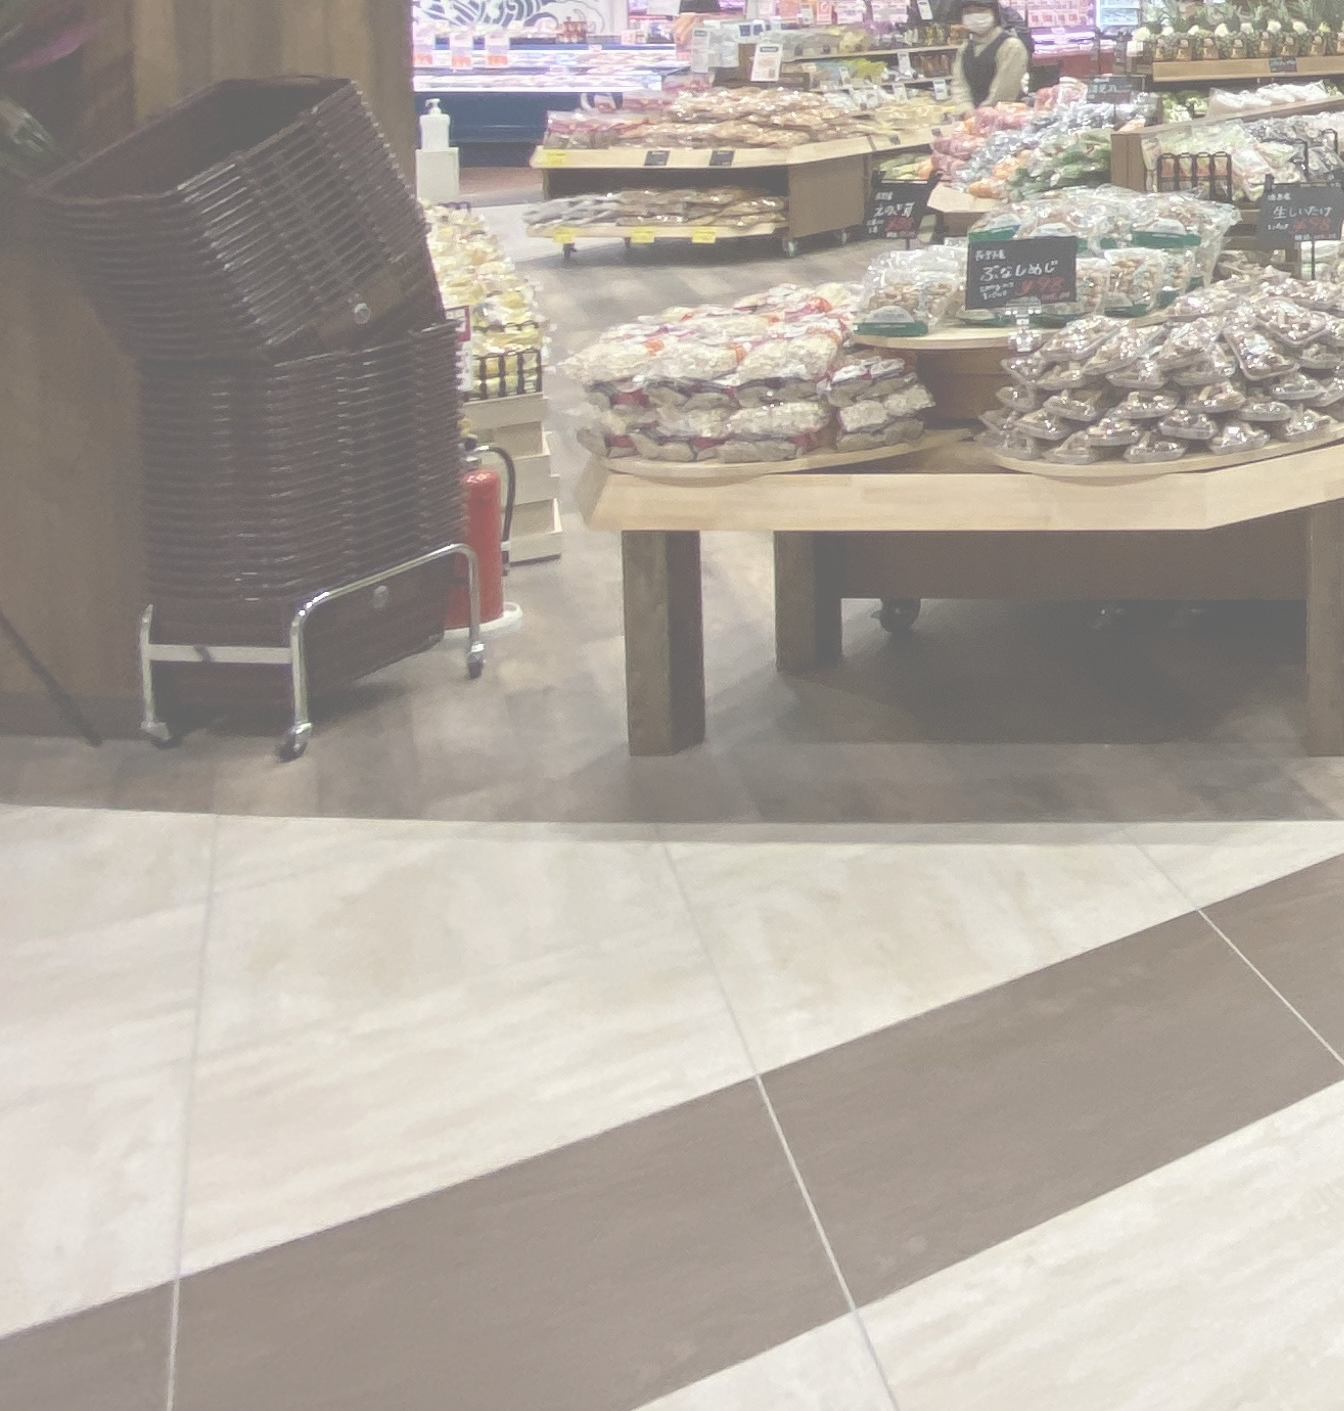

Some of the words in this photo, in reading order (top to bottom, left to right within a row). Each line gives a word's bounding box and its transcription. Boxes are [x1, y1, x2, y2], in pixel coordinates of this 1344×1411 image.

[1271, 205, 1333, 220] 生しいたけ
[979, 259, 1059, 282] ぶなしめじ
